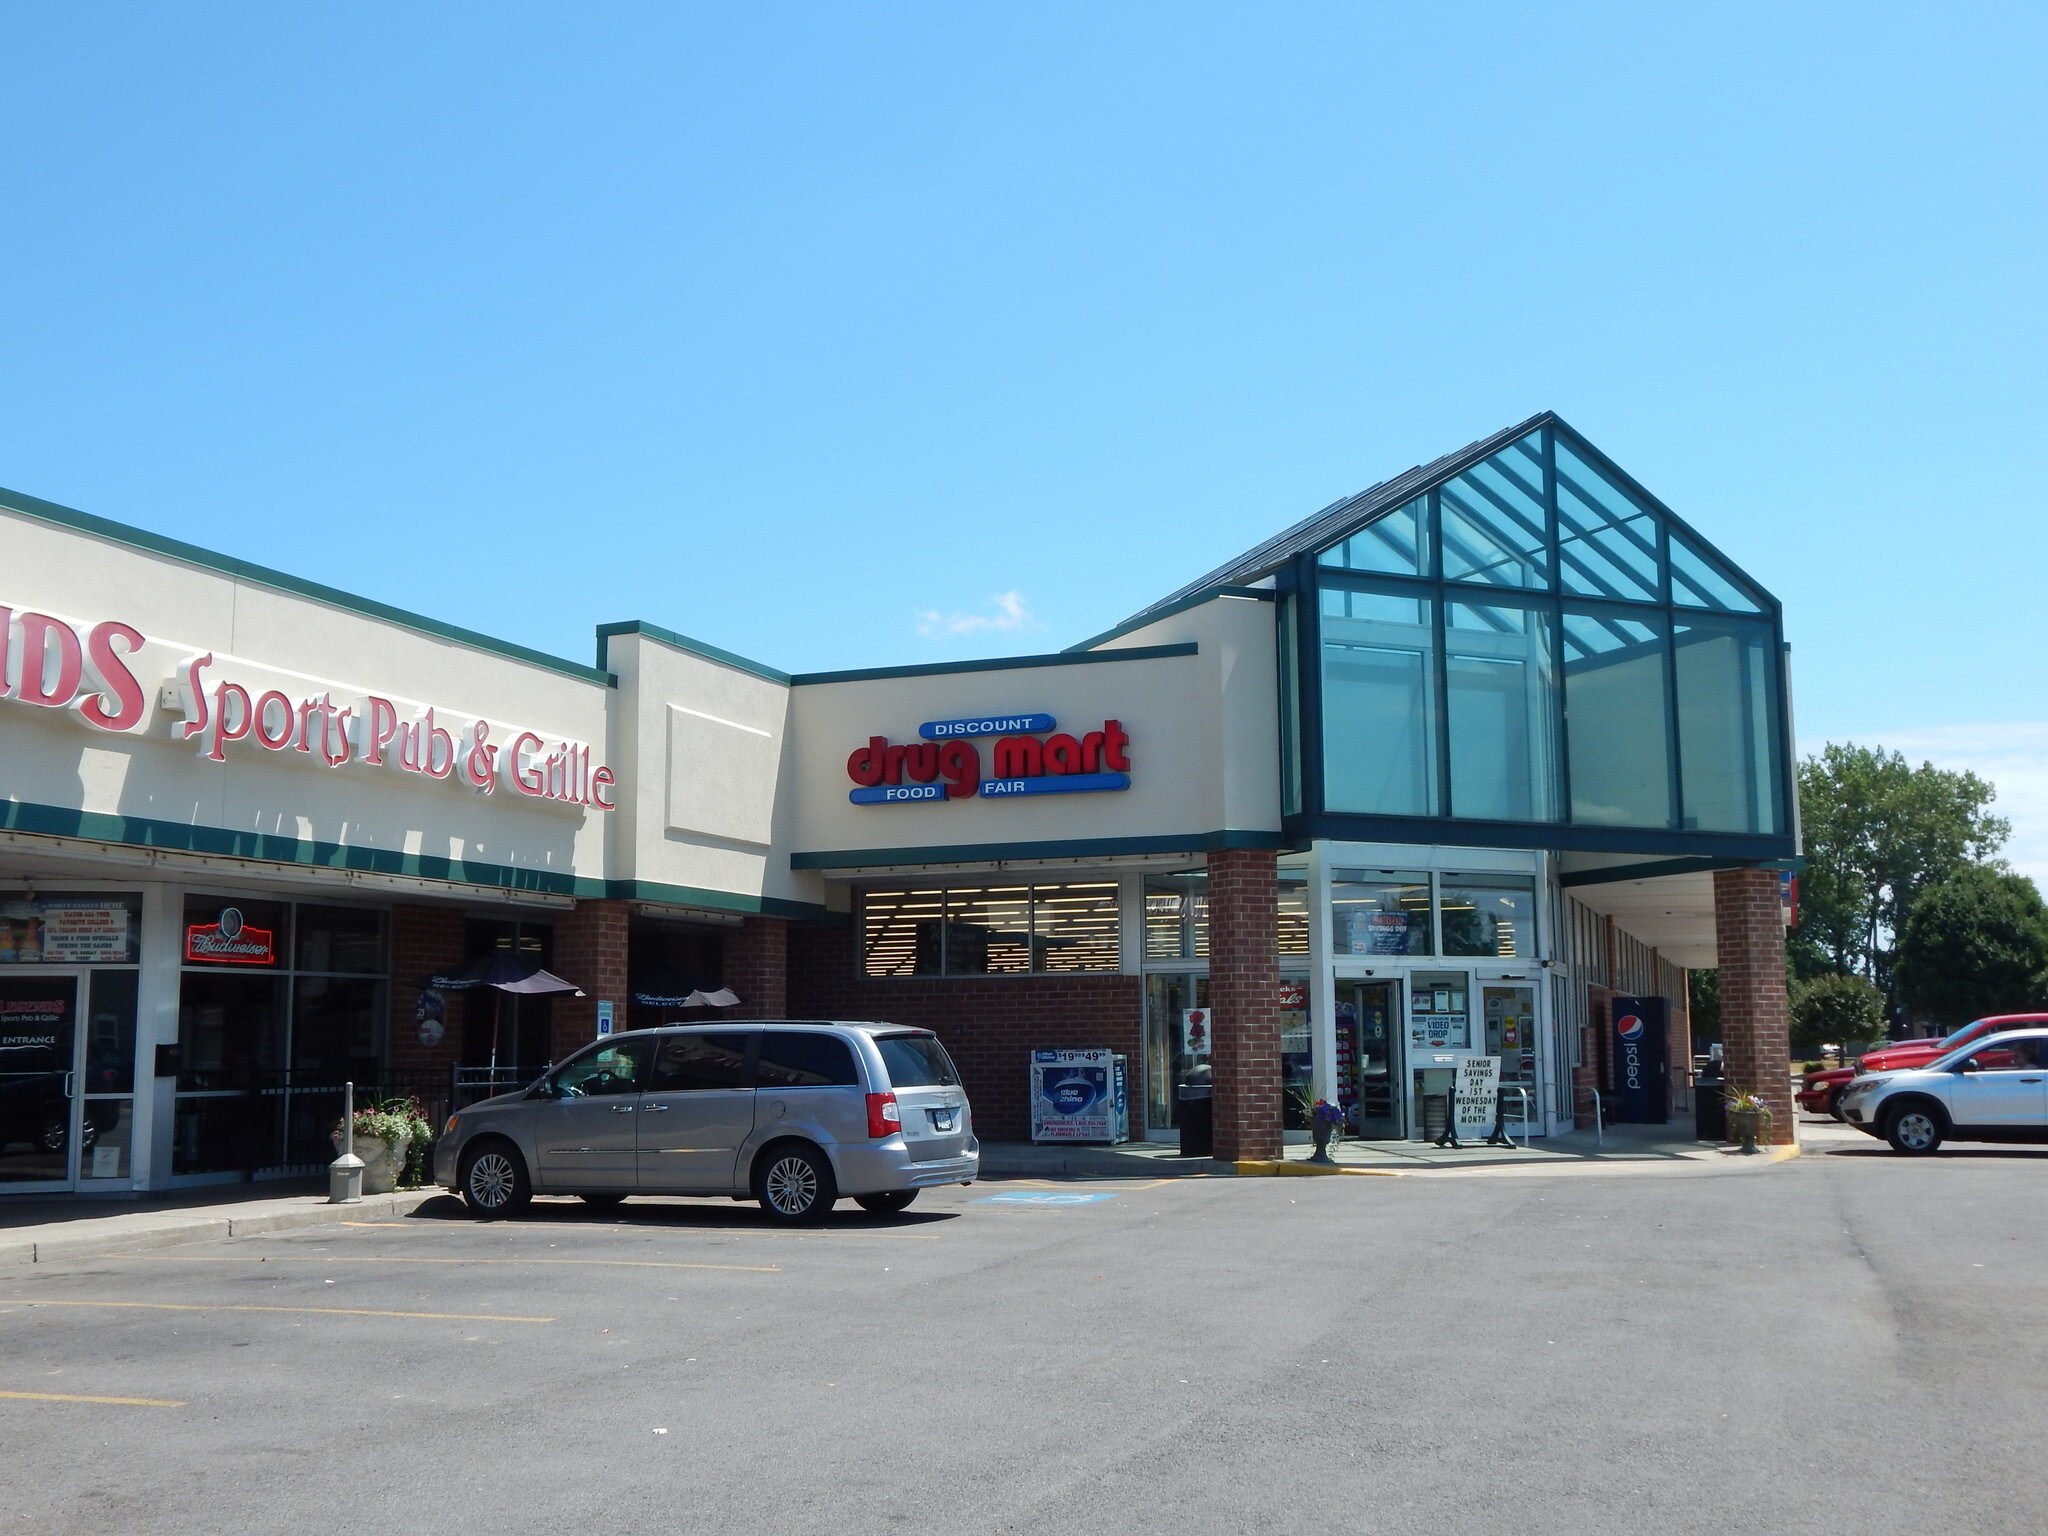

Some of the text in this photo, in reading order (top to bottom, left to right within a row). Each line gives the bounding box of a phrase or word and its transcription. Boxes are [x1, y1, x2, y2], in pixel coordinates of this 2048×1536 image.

[0, 606, 616, 811] DS Sports Pub & Grille
[935, 718, 1033, 735] DISCOUNT
[847, 719, 1131, 799] drug mart
[886, 781, 1025, 800] FOOD FAIR
[99, 901, 125, 910] HERE
[191, 933, 269, 955] Budweiser
[1427, 1021, 1450, 1029] VIDEO
[1428, 1030, 1448, 1038] DROP
[2, 1036, 56, 1044] ENTRANCE
[1467, 1059, 1492, 1068] SENIOR
[1623, 1043, 1641, 1089] pepsi
[1464, 1069, 1493, 1077] SAVINGS
[1455, 1097, 1497, 1105] WEDNESDAY
[1461, 1106, 1487, 1114] OF THE
[1460, 1115, 1487, 1123] MONTH
